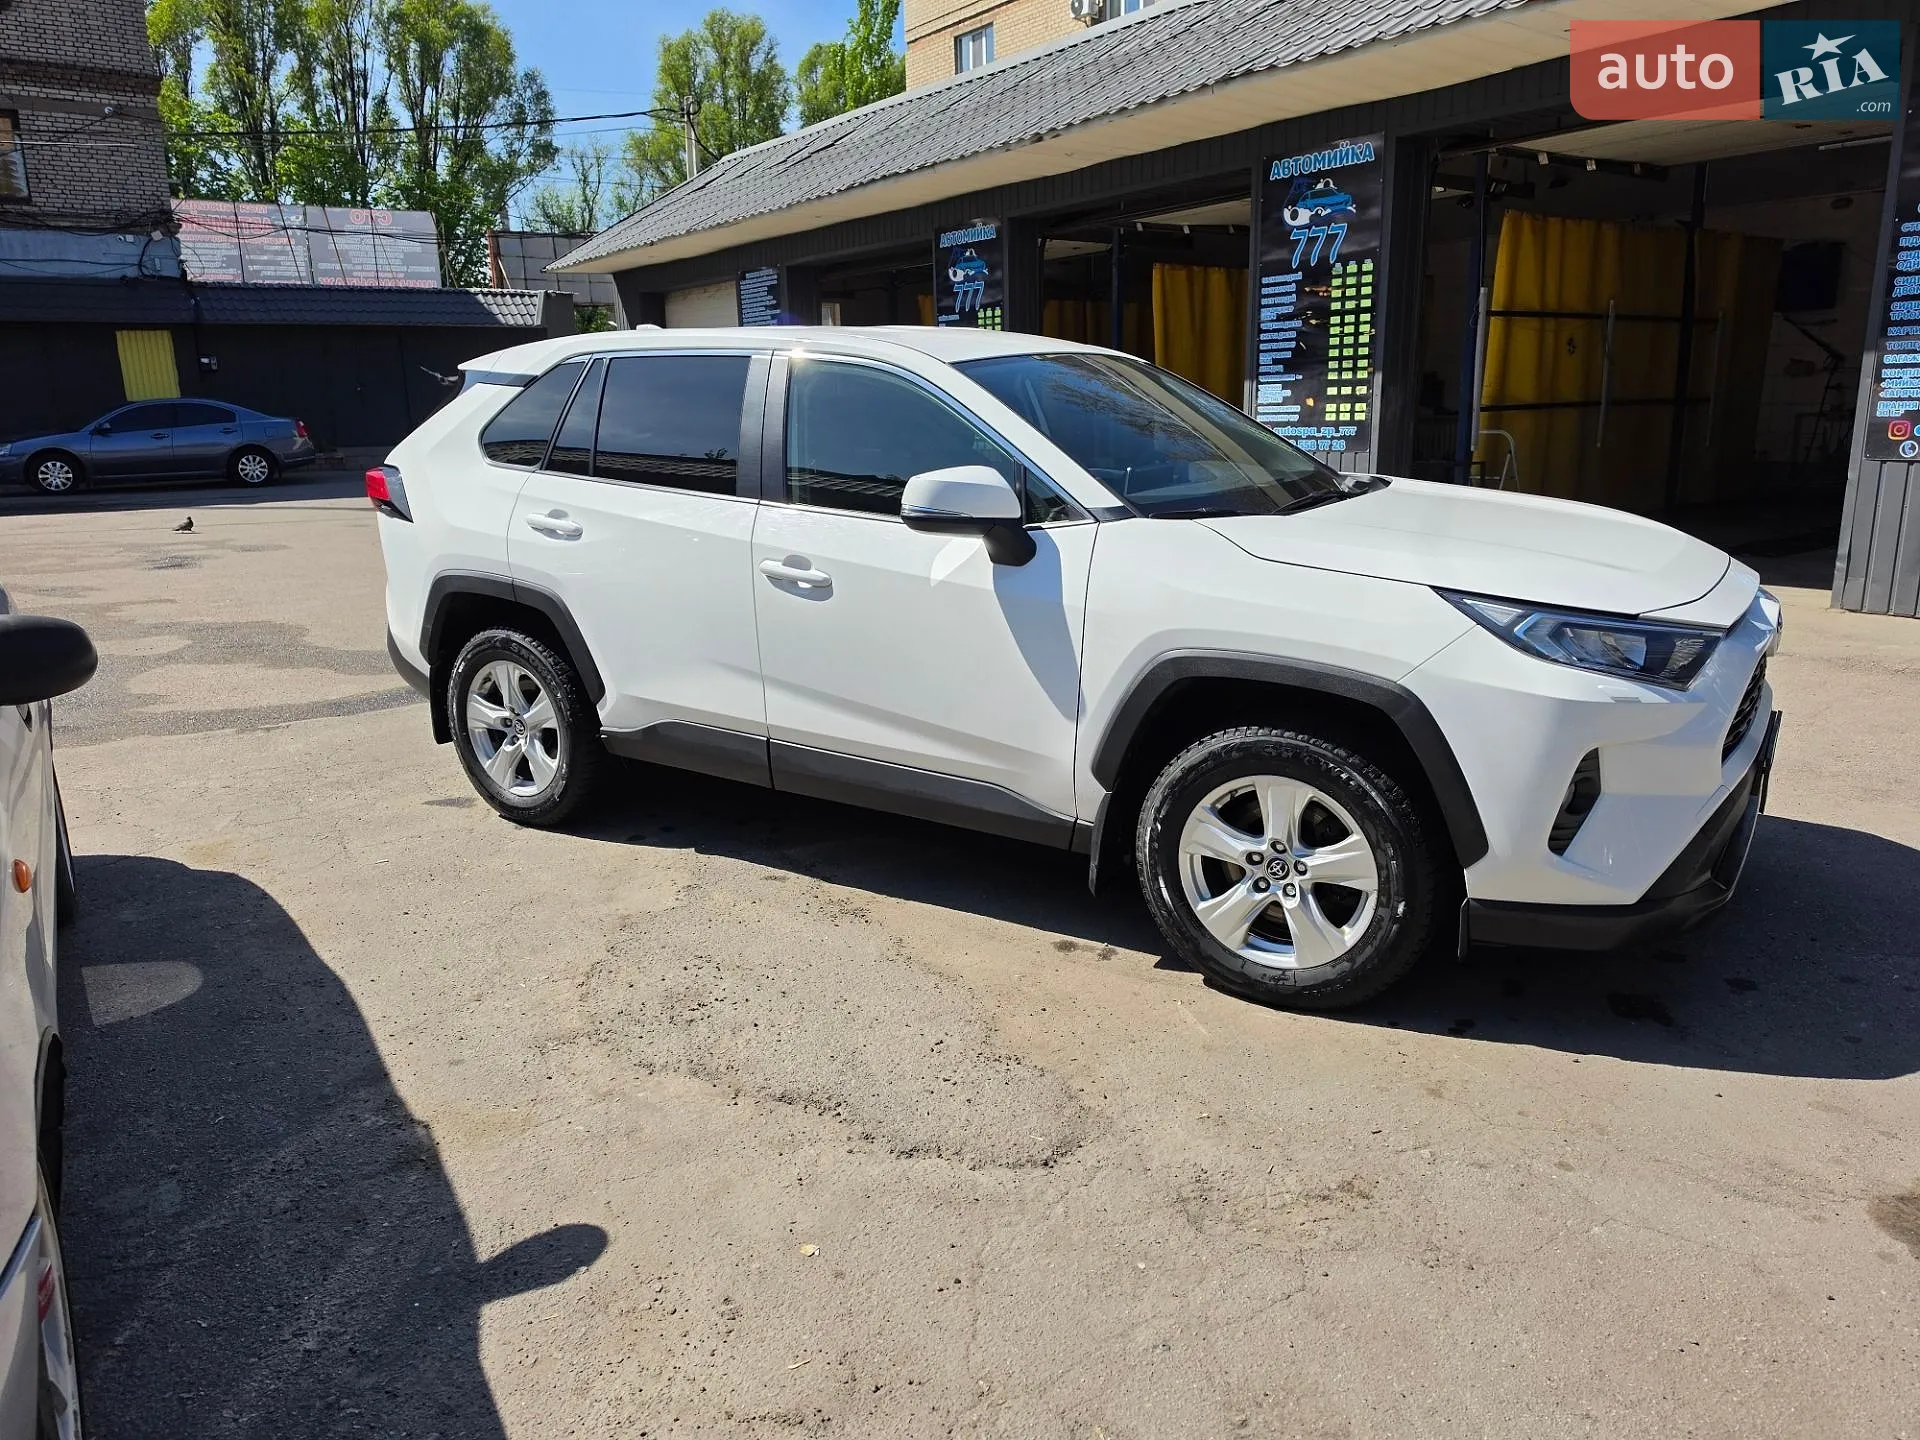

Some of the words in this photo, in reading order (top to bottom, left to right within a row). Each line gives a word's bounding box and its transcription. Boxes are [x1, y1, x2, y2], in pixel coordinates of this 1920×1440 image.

[1270, 141, 1375, 181] АВТОМИЙКА
[940, 222, 997, 248] АВТОМИЙКА
[1290, 223, 1348, 269] 777
[1899, 236, 1920, 247] ПІД
[953, 280, 985, 313] 777
[1881, 368, 1920, 378] КОМПЛ
